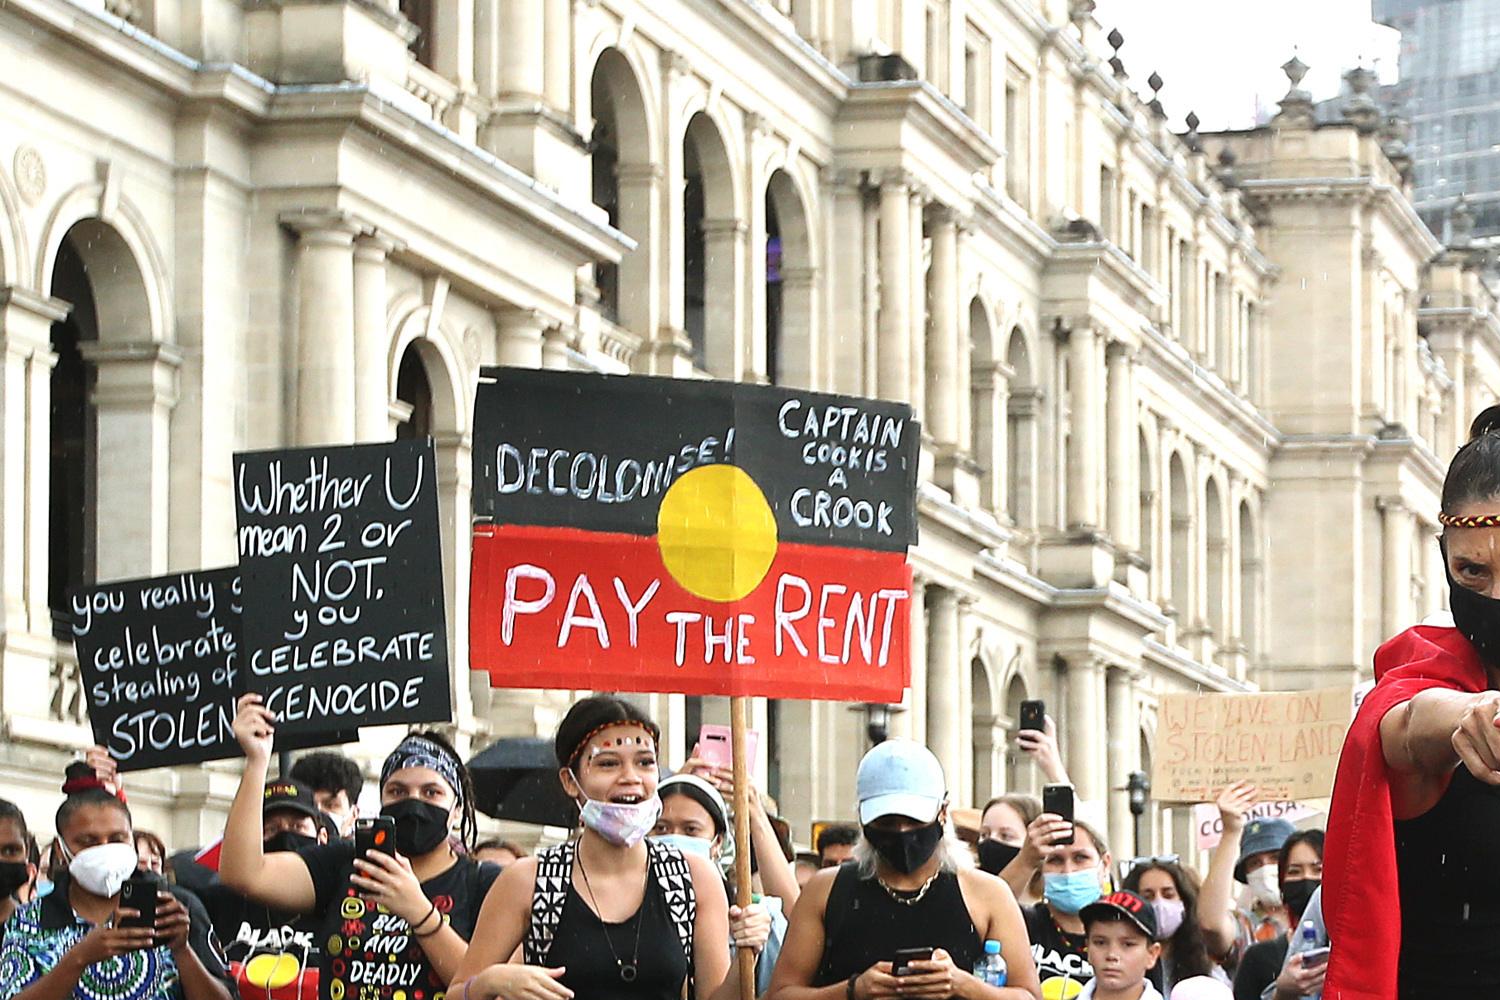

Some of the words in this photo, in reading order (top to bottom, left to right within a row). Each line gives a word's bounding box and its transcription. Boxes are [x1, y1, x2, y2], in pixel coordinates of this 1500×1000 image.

[778, 399, 904, 448] CAPTAIN
[497, 427, 735, 504] DECOLONISE!
[802, 440, 864, 471] COOK
[864, 448, 888, 472] IS
[239, 456, 373, 516] Whether
[384, 455, 424, 511] U
[828, 468, 848, 490] A
[790, 489, 893, 536] CROOK
[240, 523, 307, 558] mean
[318, 513, 346, 553] 2
[361, 519, 413, 549] or
[72, 591, 124, 636] you
[140, 574, 215, 619] really
[284, 606, 360, 640] you
[501, 563, 661, 649] PAY
[665, 612, 755, 667] THE
[775, 573, 909, 668] RENT
[94, 617, 237, 672] celebrate
[251, 632, 434, 677] CELEBRATE
[93, 667, 201, 707] stealing
[212, 651, 238, 689] of
[265, 676, 425, 722] GENOCIDE
[107, 696, 237, 760] STOLEN
[1164, 696, 1211, 731] WE
[1224, 695, 1271, 729] LIVE
[1286, 694, 1322, 725] ON
[1167, 728, 1265, 765] STOLEN
[1279, 723, 1345, 763] LAND
[363, 934, 408, 954] AND
[372, 914, 409, 932] BLA
[350, 960, 422, 986] DEADLY
